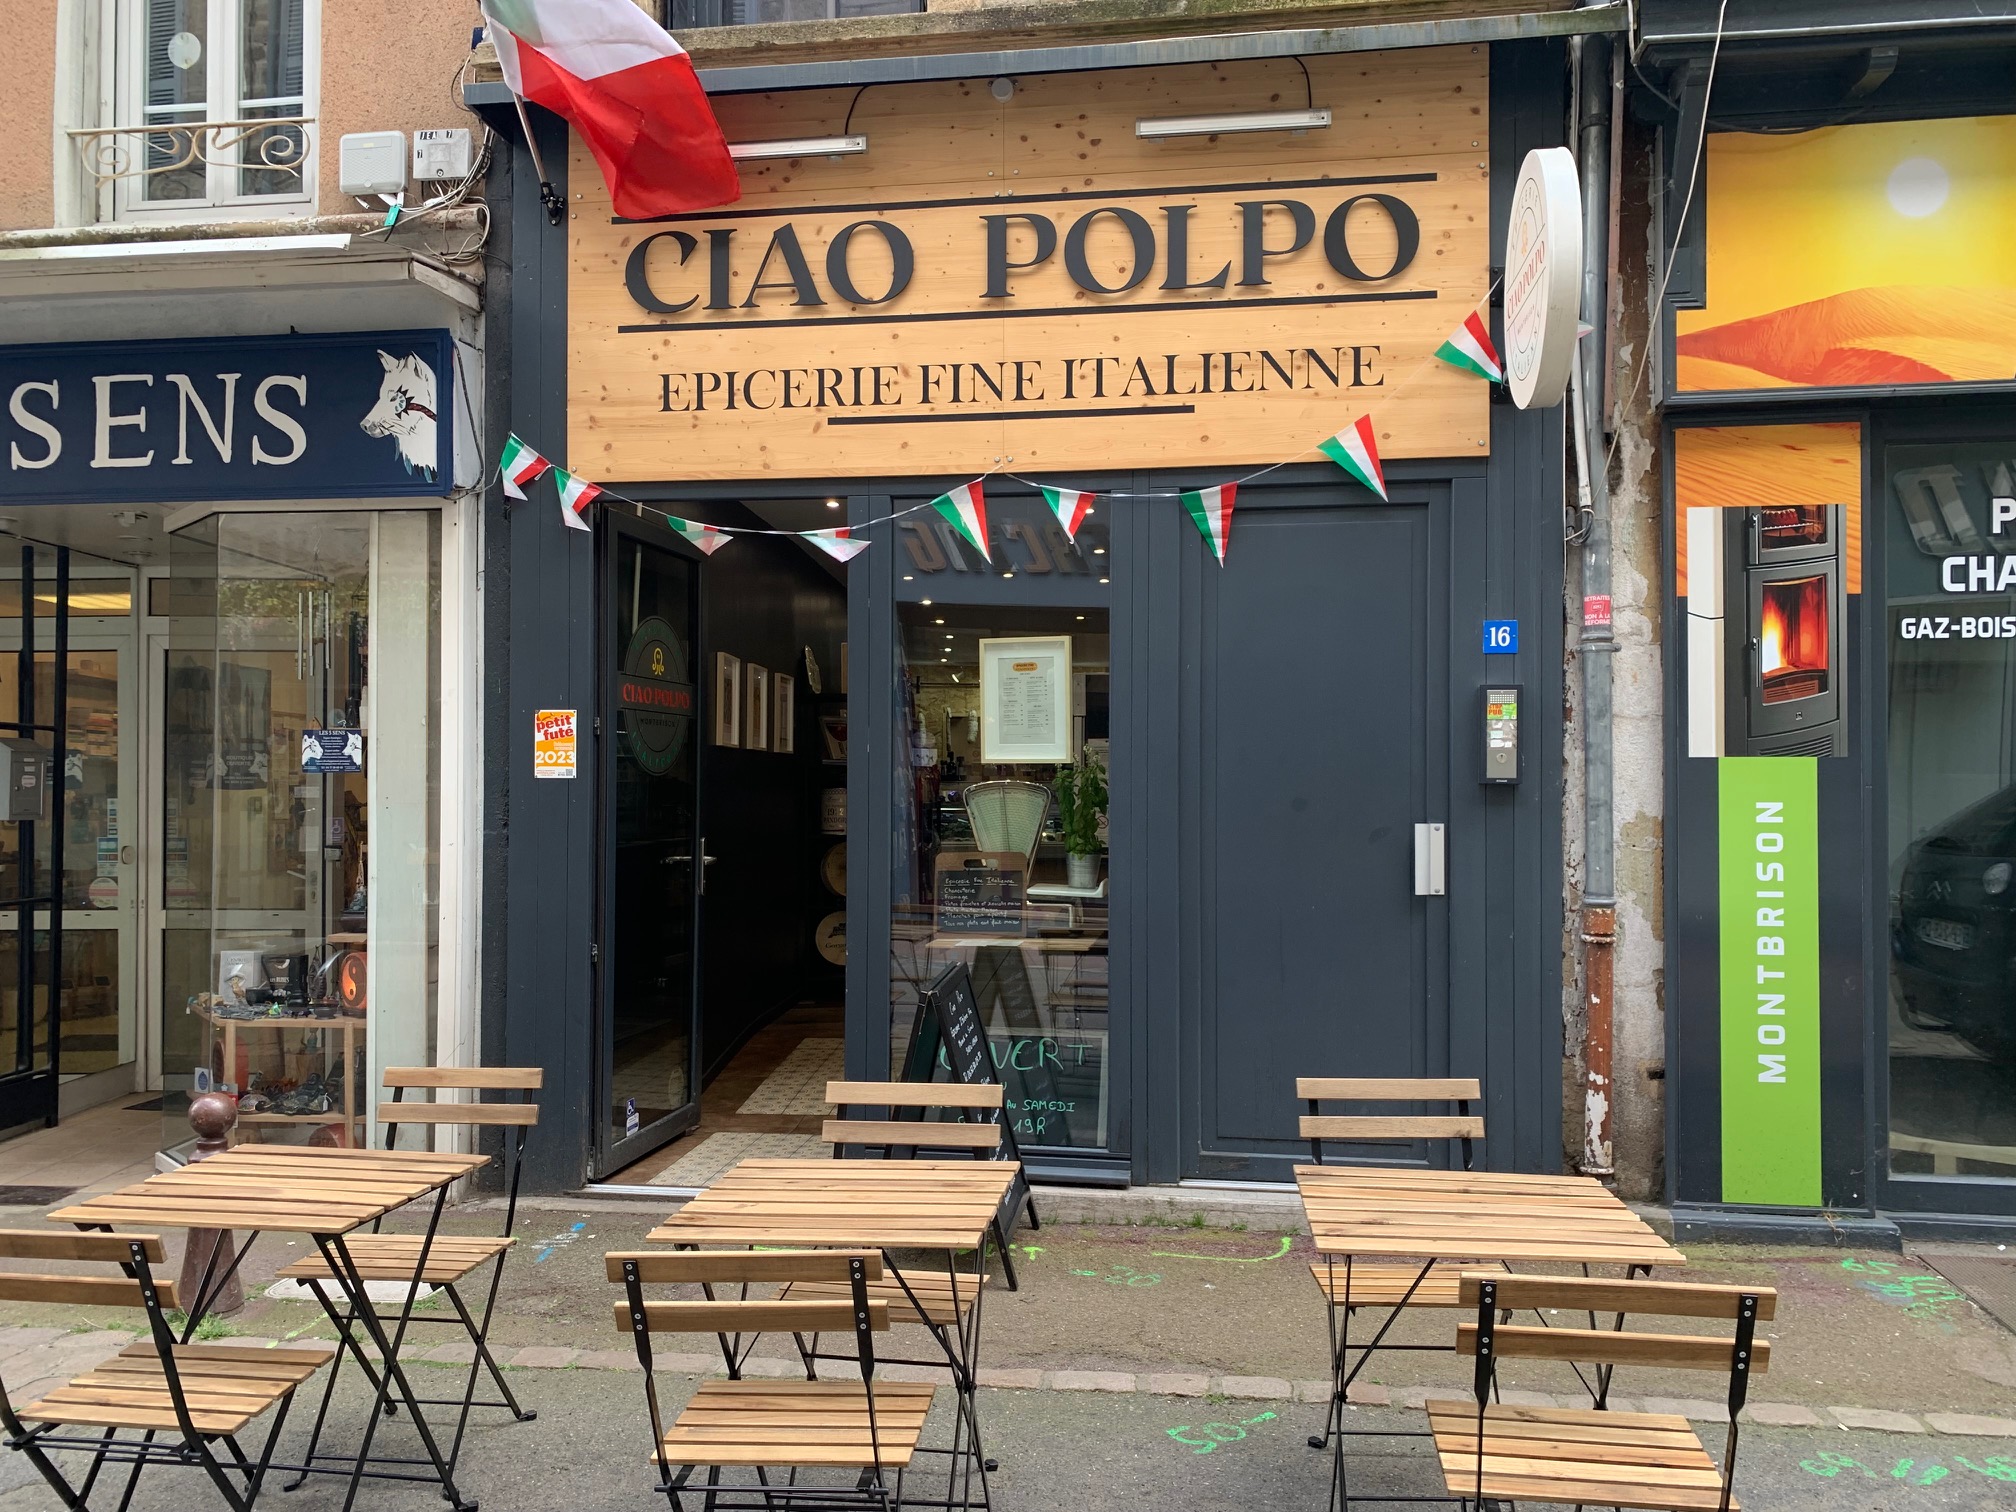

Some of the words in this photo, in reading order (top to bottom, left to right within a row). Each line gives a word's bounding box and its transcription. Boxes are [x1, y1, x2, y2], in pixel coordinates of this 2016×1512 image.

[624, 220, 914, 315] CIAO
[978, 193, 1420, 299] POLPO
[1507, 281, 1523, 319] CIAO
[1523, 240, 1546, 295] POLPO
[660, 366, 902, 413] EPICERIE
[919, 360, 1045, 405] FINE
[1061, 346, 1385, 400] ITALIENNE
[9, 373, 308, 471] SENS
[1489, 626, 1511, 647] 16
[623, 683, 653, 704] CIAO
[655, 688, 690, 710] POLPO
[536, 714, 572, 733] petit
[543, 725, 574, 740] futé
[535, 750, 575, 764] 2023
[1755, 801, 1786, 1083] MONTBRISON
[939, 1037, 1094, 1072] VERT
[1021, 1099, 1076, 1112] SAMEDI
